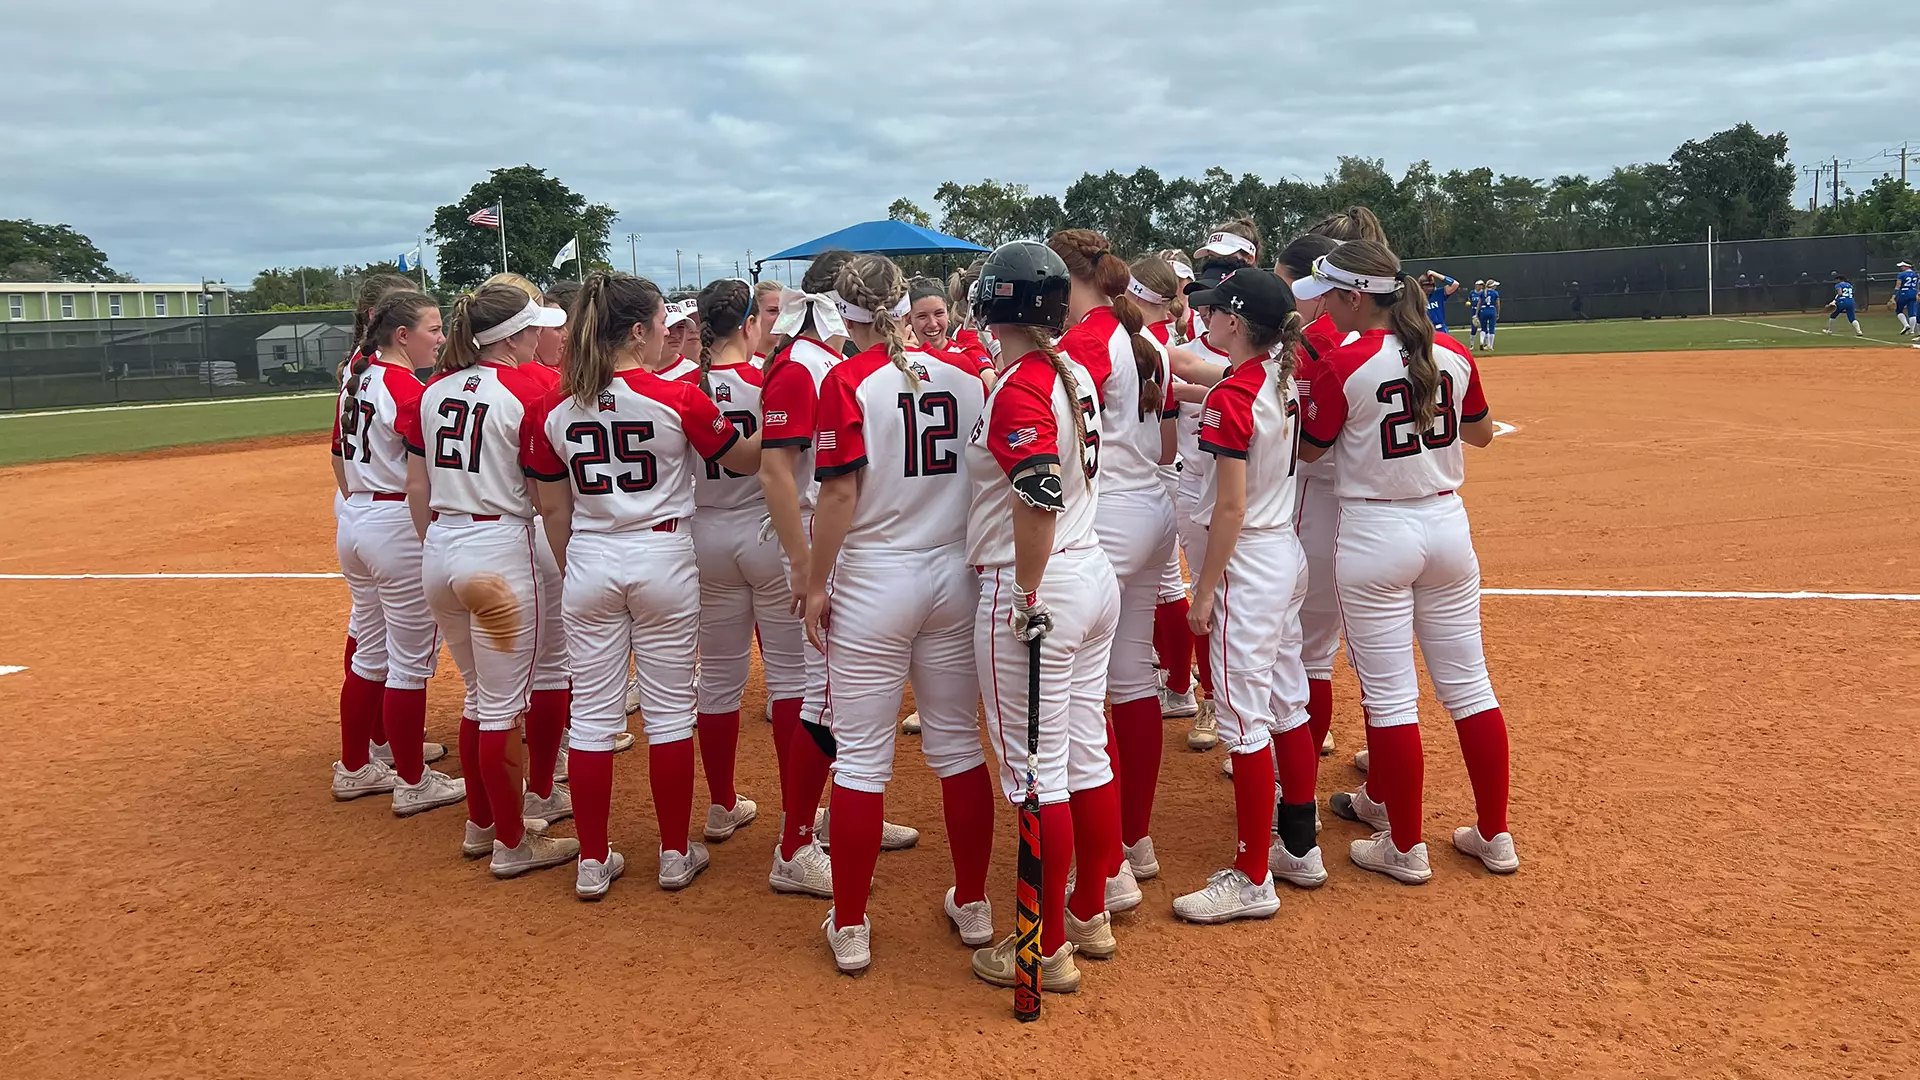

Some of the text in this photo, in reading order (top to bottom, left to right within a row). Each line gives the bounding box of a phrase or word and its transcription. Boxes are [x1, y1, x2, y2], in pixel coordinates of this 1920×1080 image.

[1035, 295, 1043, 308] 5
[434, 397, 490, 474] 21
[565, 420, 658, 496] 25
[897, 390, 959, 478] 12
[1078, 394, 1100, 480] 5
